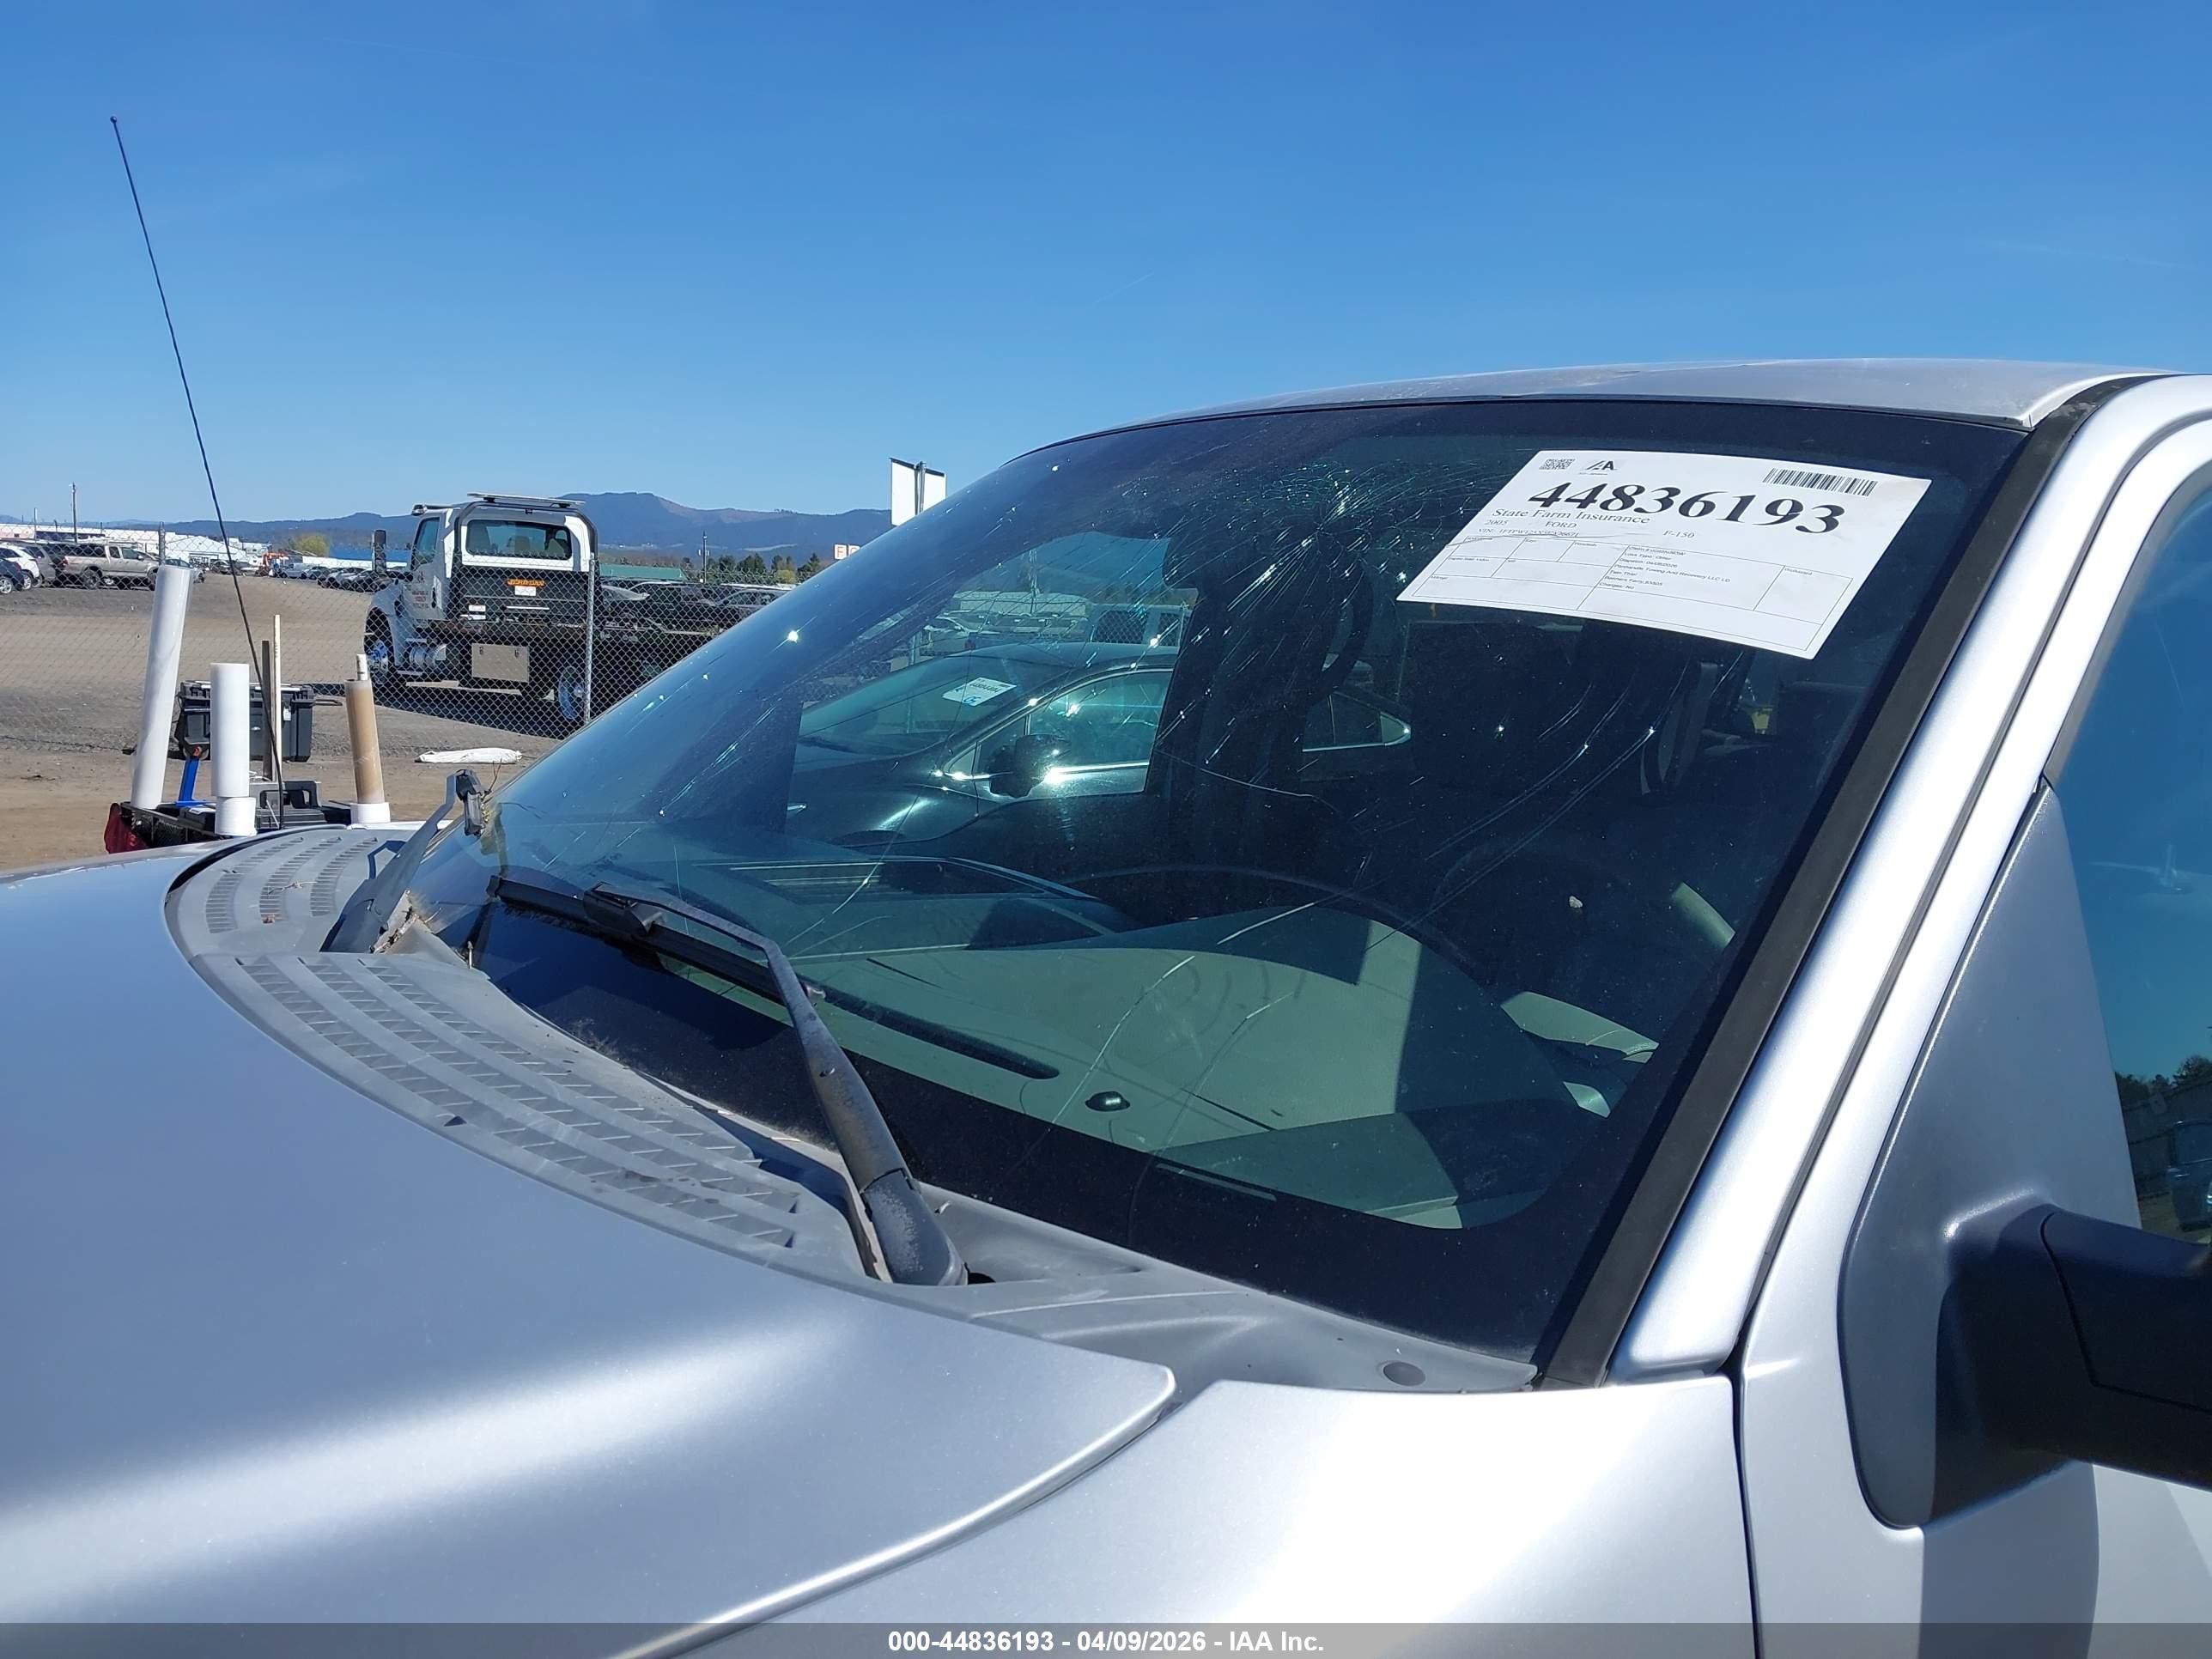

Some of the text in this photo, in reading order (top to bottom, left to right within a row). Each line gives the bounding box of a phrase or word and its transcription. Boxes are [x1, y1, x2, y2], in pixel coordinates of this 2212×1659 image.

[1492, 508, 1650, 524] State Farm Insurance
[1528, 482, 1845, 534] 44836193
[1545, 520, 1577, 529] FORD
[1662, 530, 1695, 538] F-150
